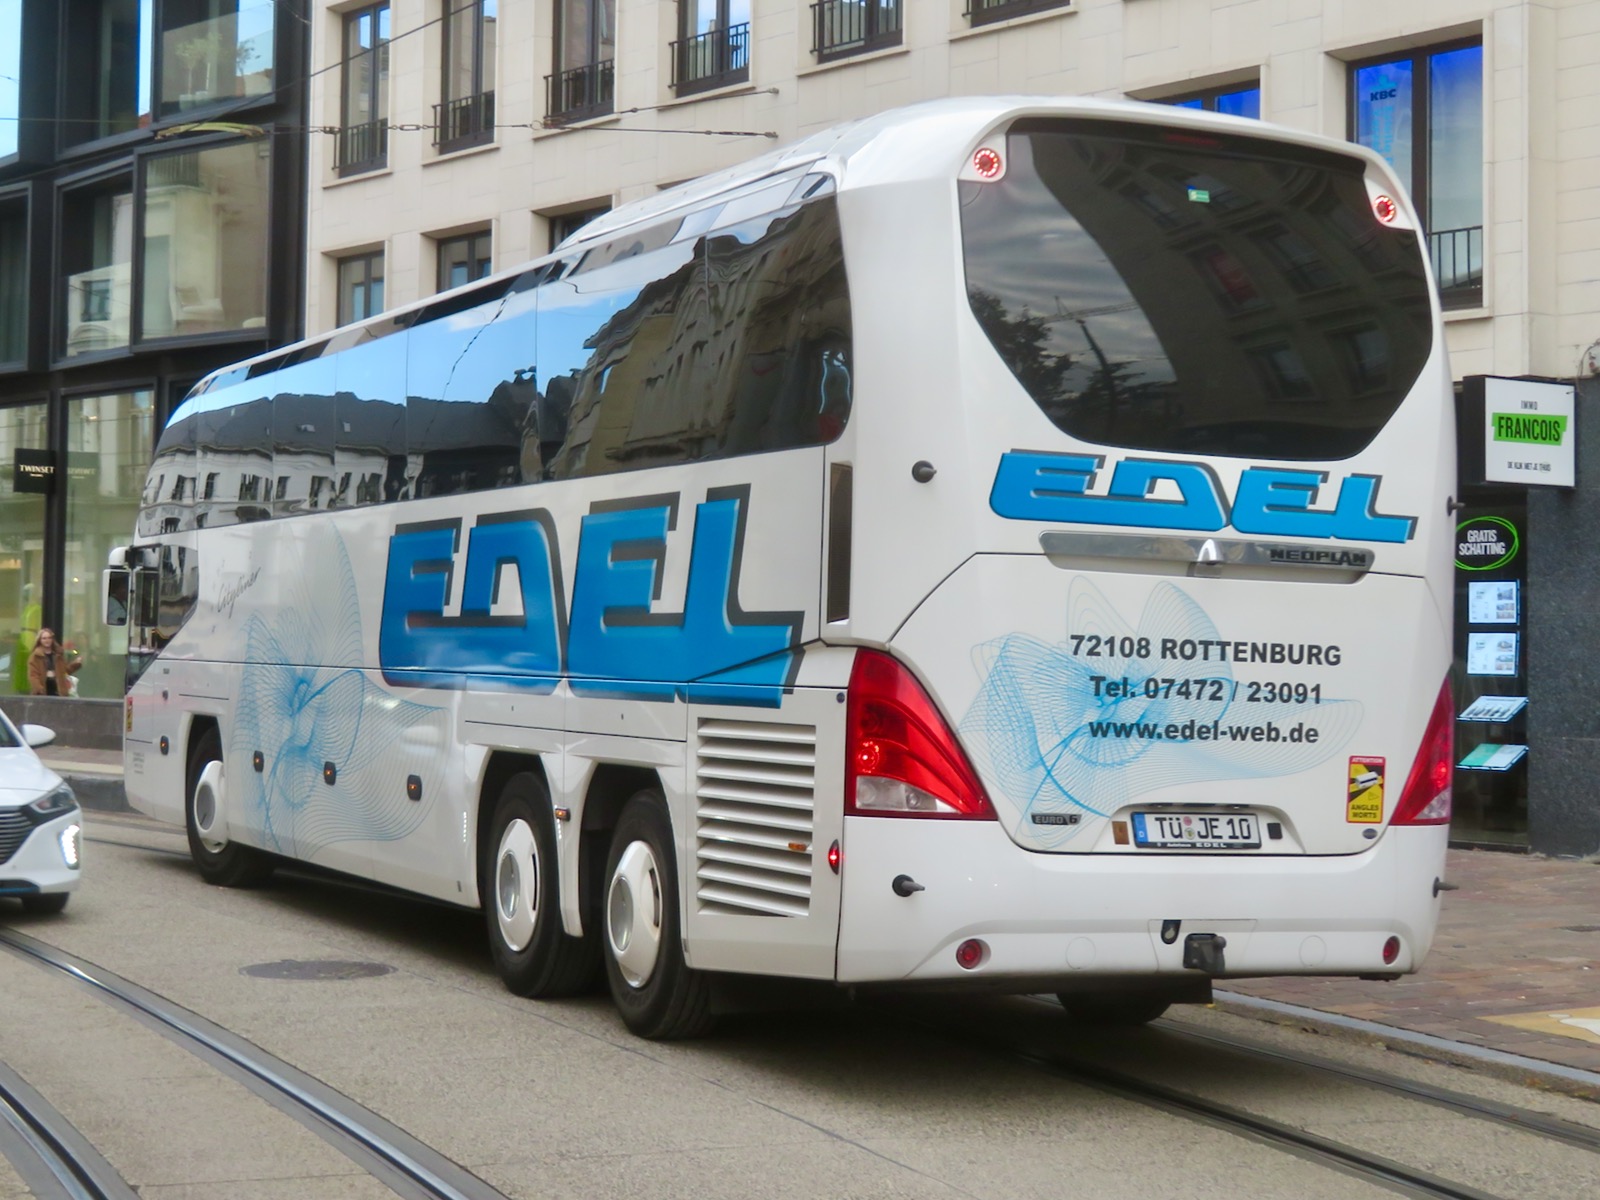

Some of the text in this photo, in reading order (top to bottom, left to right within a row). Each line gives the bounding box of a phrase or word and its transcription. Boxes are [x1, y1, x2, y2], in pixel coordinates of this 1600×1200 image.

[1370, 89, 1396, 101] KBC
[1498, 416, 1560, 442] FRANCOIS
[19, 464, 55, 474] TWINSET
[989, 448, 1418, 544] EDEL
[1467, 530, 1497, 542] GRATIS
[1269, 549, 1366, 566] NEOPLAN
[1459, 542, 1506, 556] SCHATTING
[379, 483, 805, 708] EDEL
[1070, 635, 1341, 666] 72108 ROTTENBURG
[1090, 676, 1136, 698] Tel.
[1144, 678, 1224, 701] 07472
[1247, 681, 1321, 704] 23091
[1089, 719, 1319, 743] www.edel-web.de
[1035, 815, 1078, 824] EURO 6
[1155, 817, 1183, 839] TÜ
